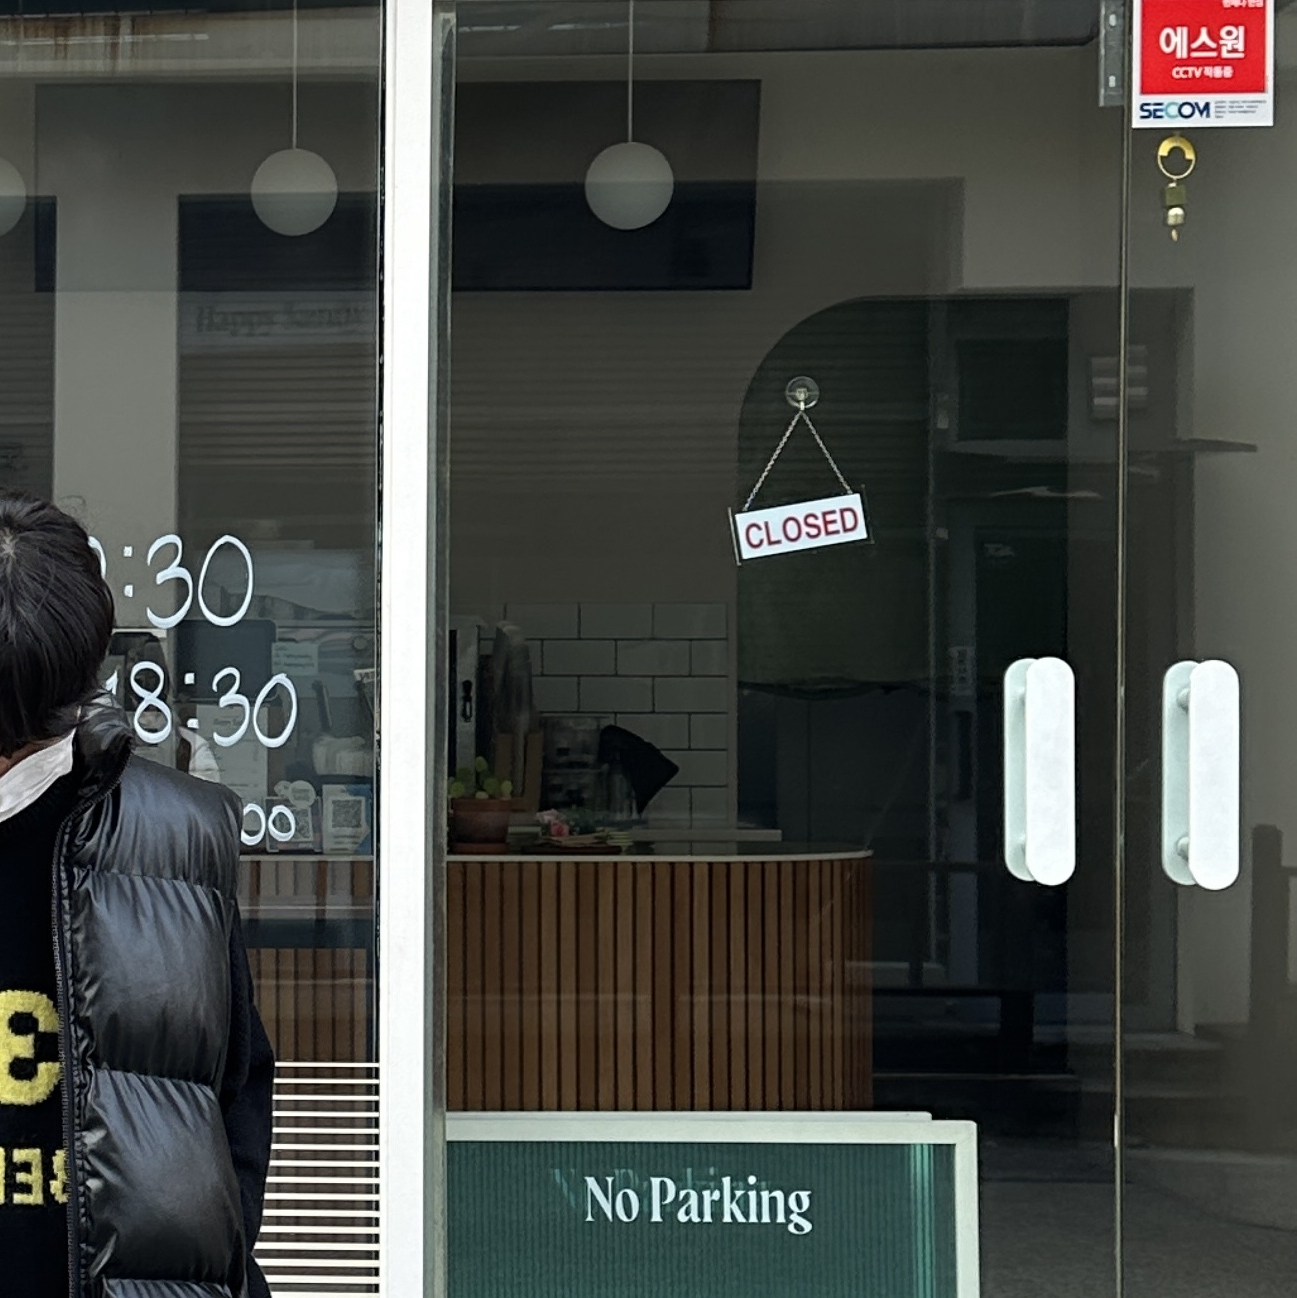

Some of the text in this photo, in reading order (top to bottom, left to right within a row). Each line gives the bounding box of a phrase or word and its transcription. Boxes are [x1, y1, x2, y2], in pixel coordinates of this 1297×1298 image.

[1159, 25, 1245, 59] 에스원
[1172, 66, 1202, 79] CCTV
[1139, 101, 1211, 120] SECOM
[745, 507, 859, 549] CLOSED
[584, 1175, 813, 1235] No Parking
